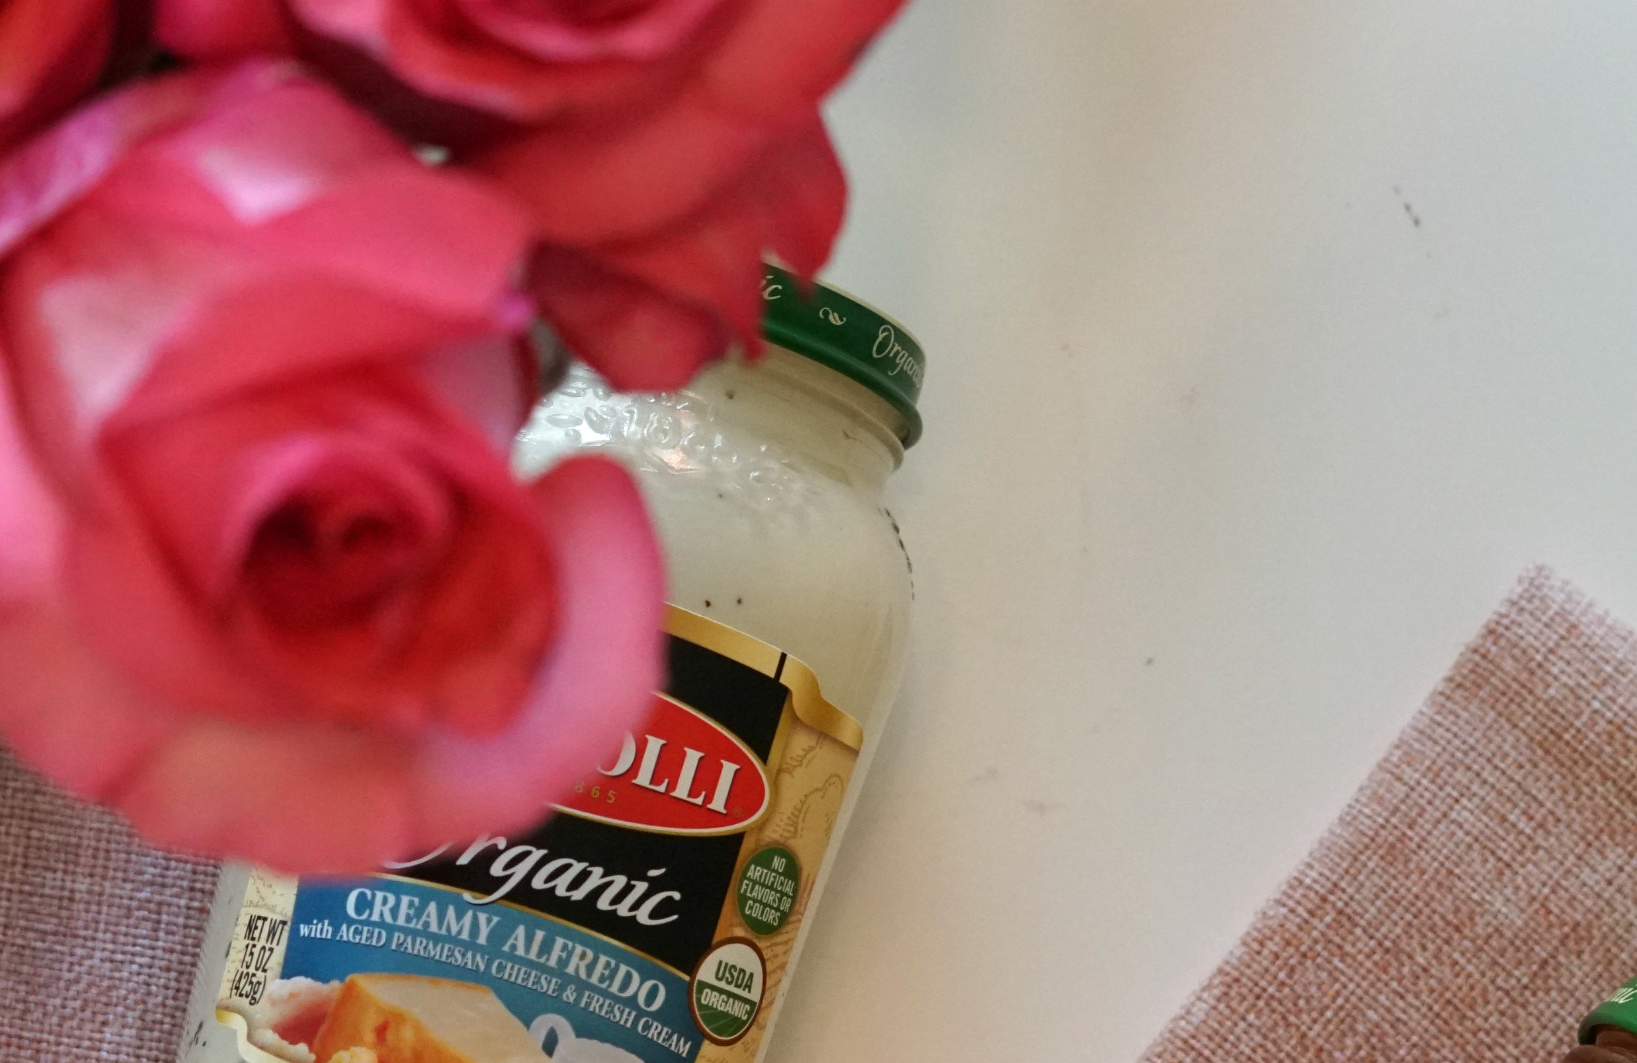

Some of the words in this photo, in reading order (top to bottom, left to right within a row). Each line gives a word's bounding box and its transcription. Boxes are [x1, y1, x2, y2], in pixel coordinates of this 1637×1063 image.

[596, 730, 741, 814] OLLI
[573, 780, 617, 804] 865
[746, 864, 795, 896] ARTIFICIAL
[772, 855, 786, 873] NO
[741, 880, 780, 908] FLAVORS
[779, 893, 792, 913] OR
[244, 914, 268, 943] NET
[266, 918, 288, 946] WT
[745, 900, 781, 927] COLORS
[241, 943, 256, 969] 15
[254, 945, 275, 973] OZ
[346, 887, 501, 946] CREAMY
[501, 924, 666, 1012] ALFREDO
[229, 970, 267, 1006] (425g)
[299, 919, 332, 939] with
[336, 923, 387, 948] AGED
[390, 931, 489, 973] PARMESAN
[491, 959, 561, 998] CHEESE
[562, 984, 577, 1005] &
[580, 990, 637, 1029] FRESH
[637, 1017, 692, 1058] CREAM
[714, 959, 754, 994] USDA
[700, 988, 751, 1021] ORGANIC
